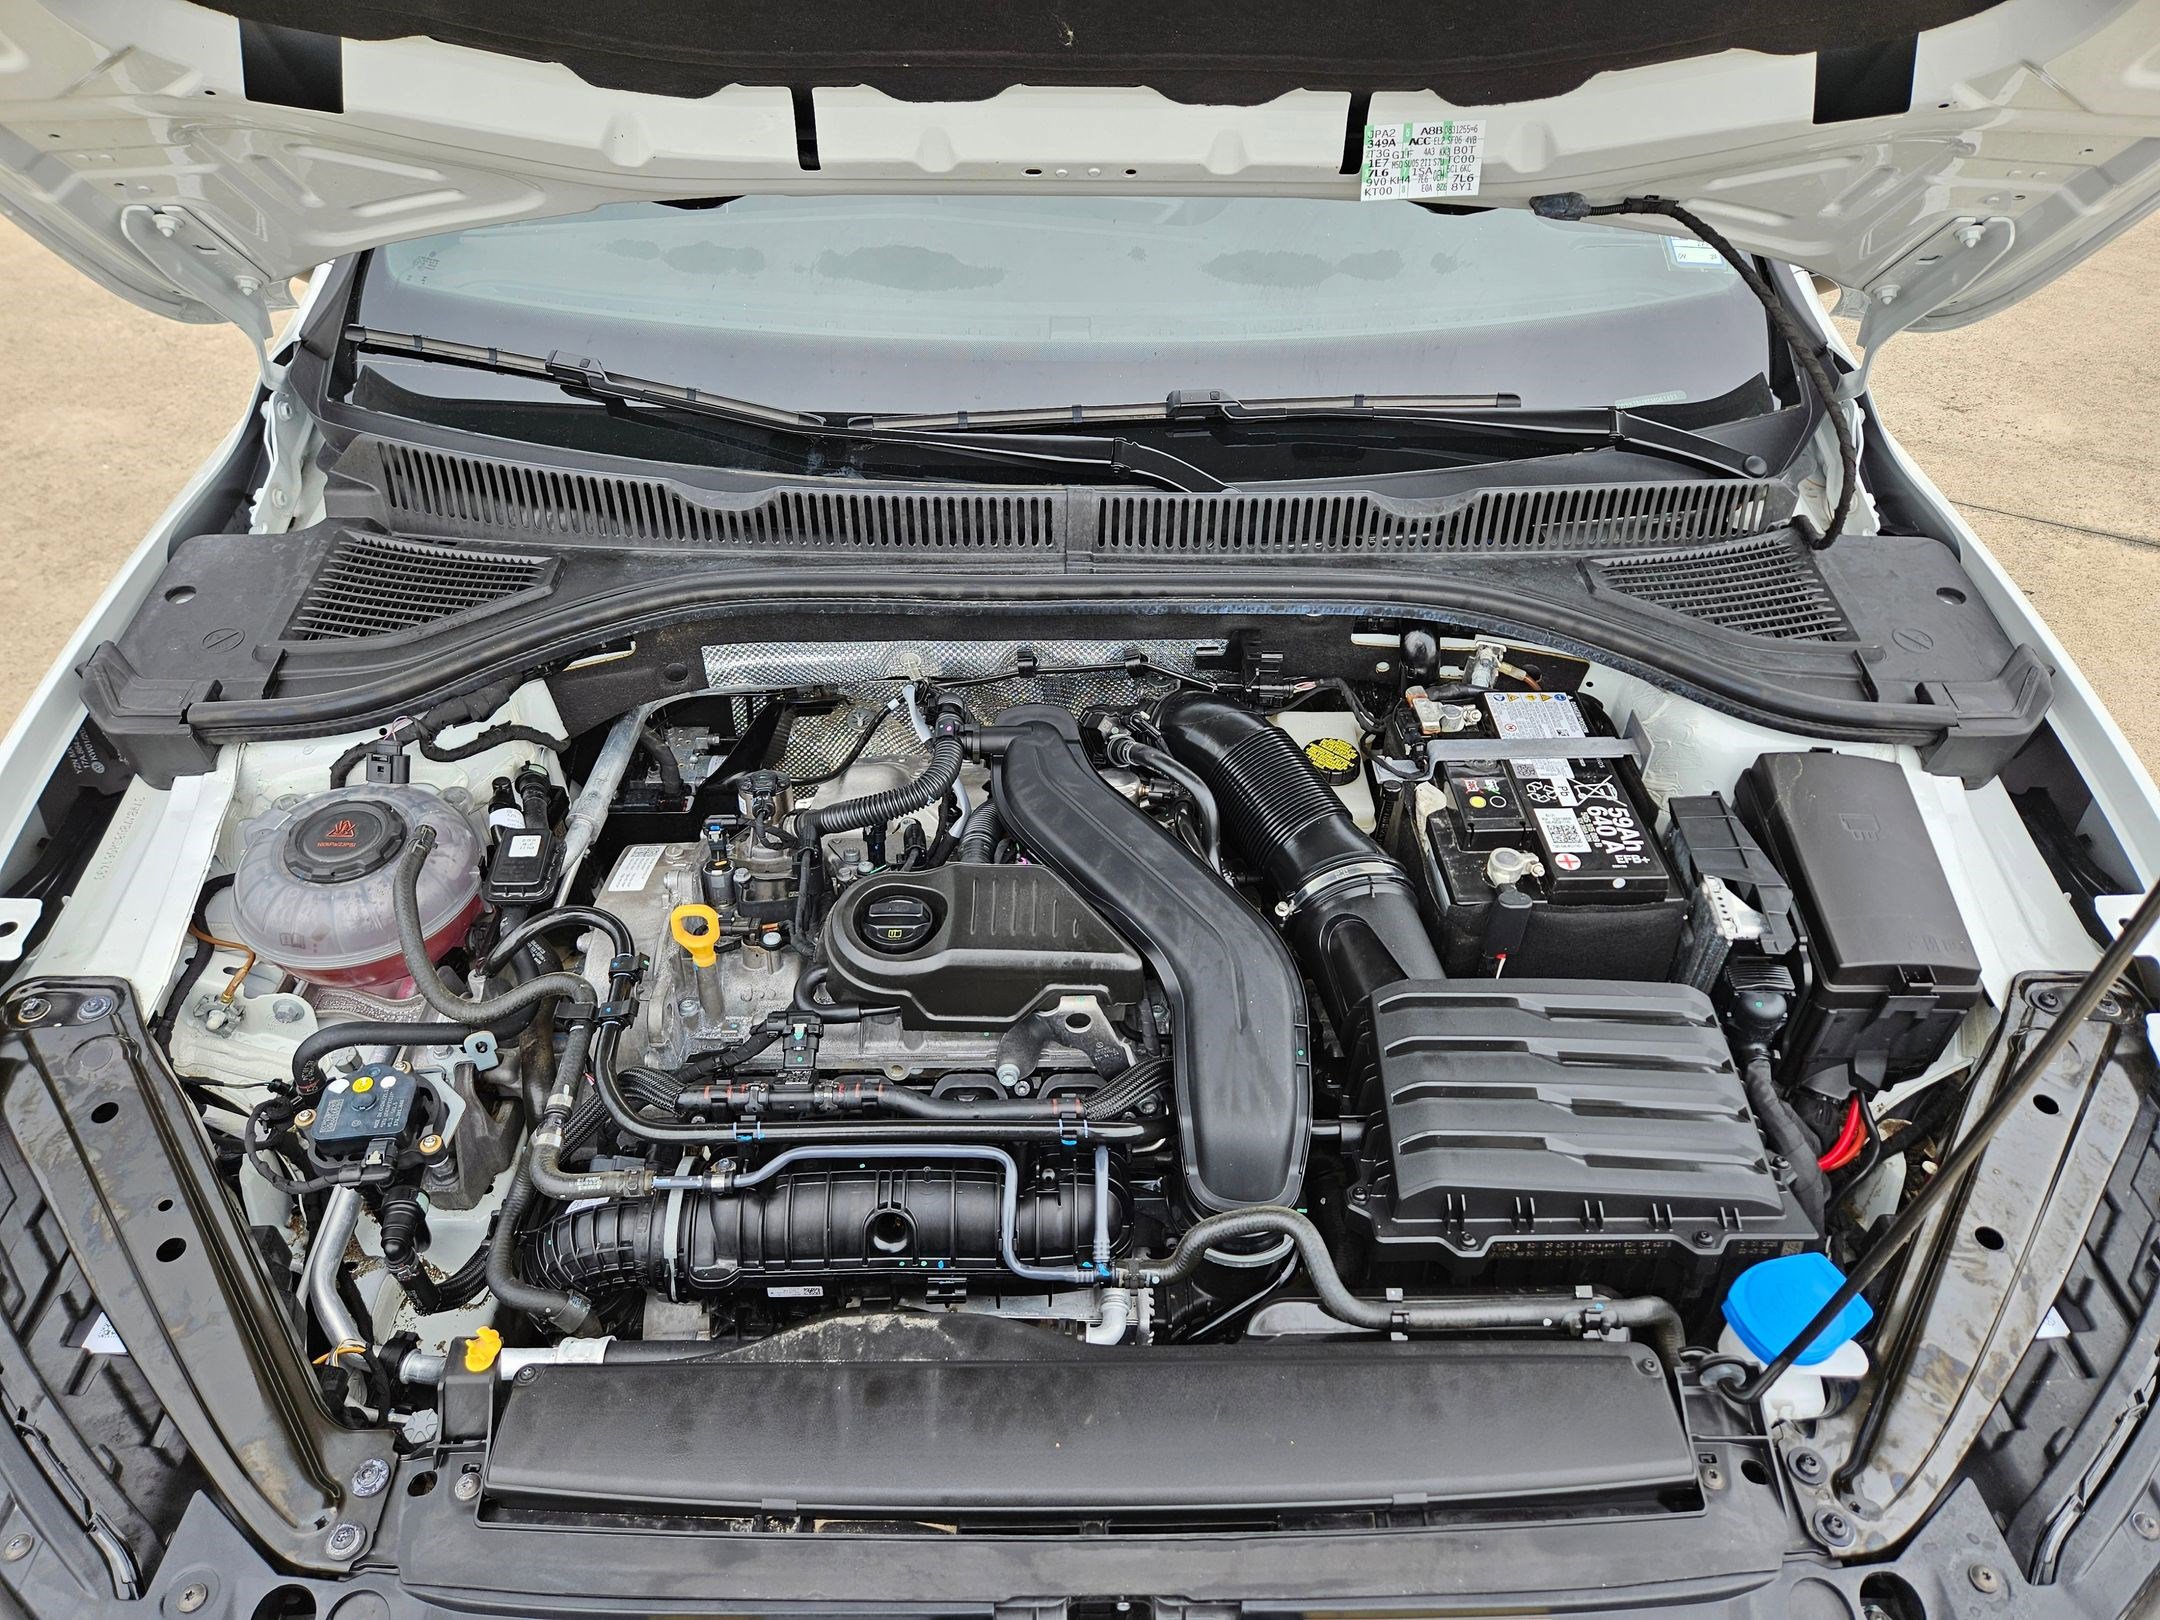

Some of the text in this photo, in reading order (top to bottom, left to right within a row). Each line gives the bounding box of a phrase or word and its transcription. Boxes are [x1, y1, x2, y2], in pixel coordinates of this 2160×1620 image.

[1367, 129, 1396, 139] JPA2
[1367, 138, 1396, 149] 349A
[1409, 136, 1432, 146] ACC
[1368, 158, 1390, 168] 1E7
[1368, 168, 1389, 178] 7L6
[1389, 175, 1410, 185] KH4
[1453, 173, 1475, 183] 7L6
[1450, 182, 1473, 192] 8Y1
[1559, 785, 1570, 797] Pb
[1586, 805, 1619, 838] 640
[1607, 806, 1645, 852] 59Ah
[1600, 839, 1626, 855] A
[1614, 854, 1651, 864] EFB+
